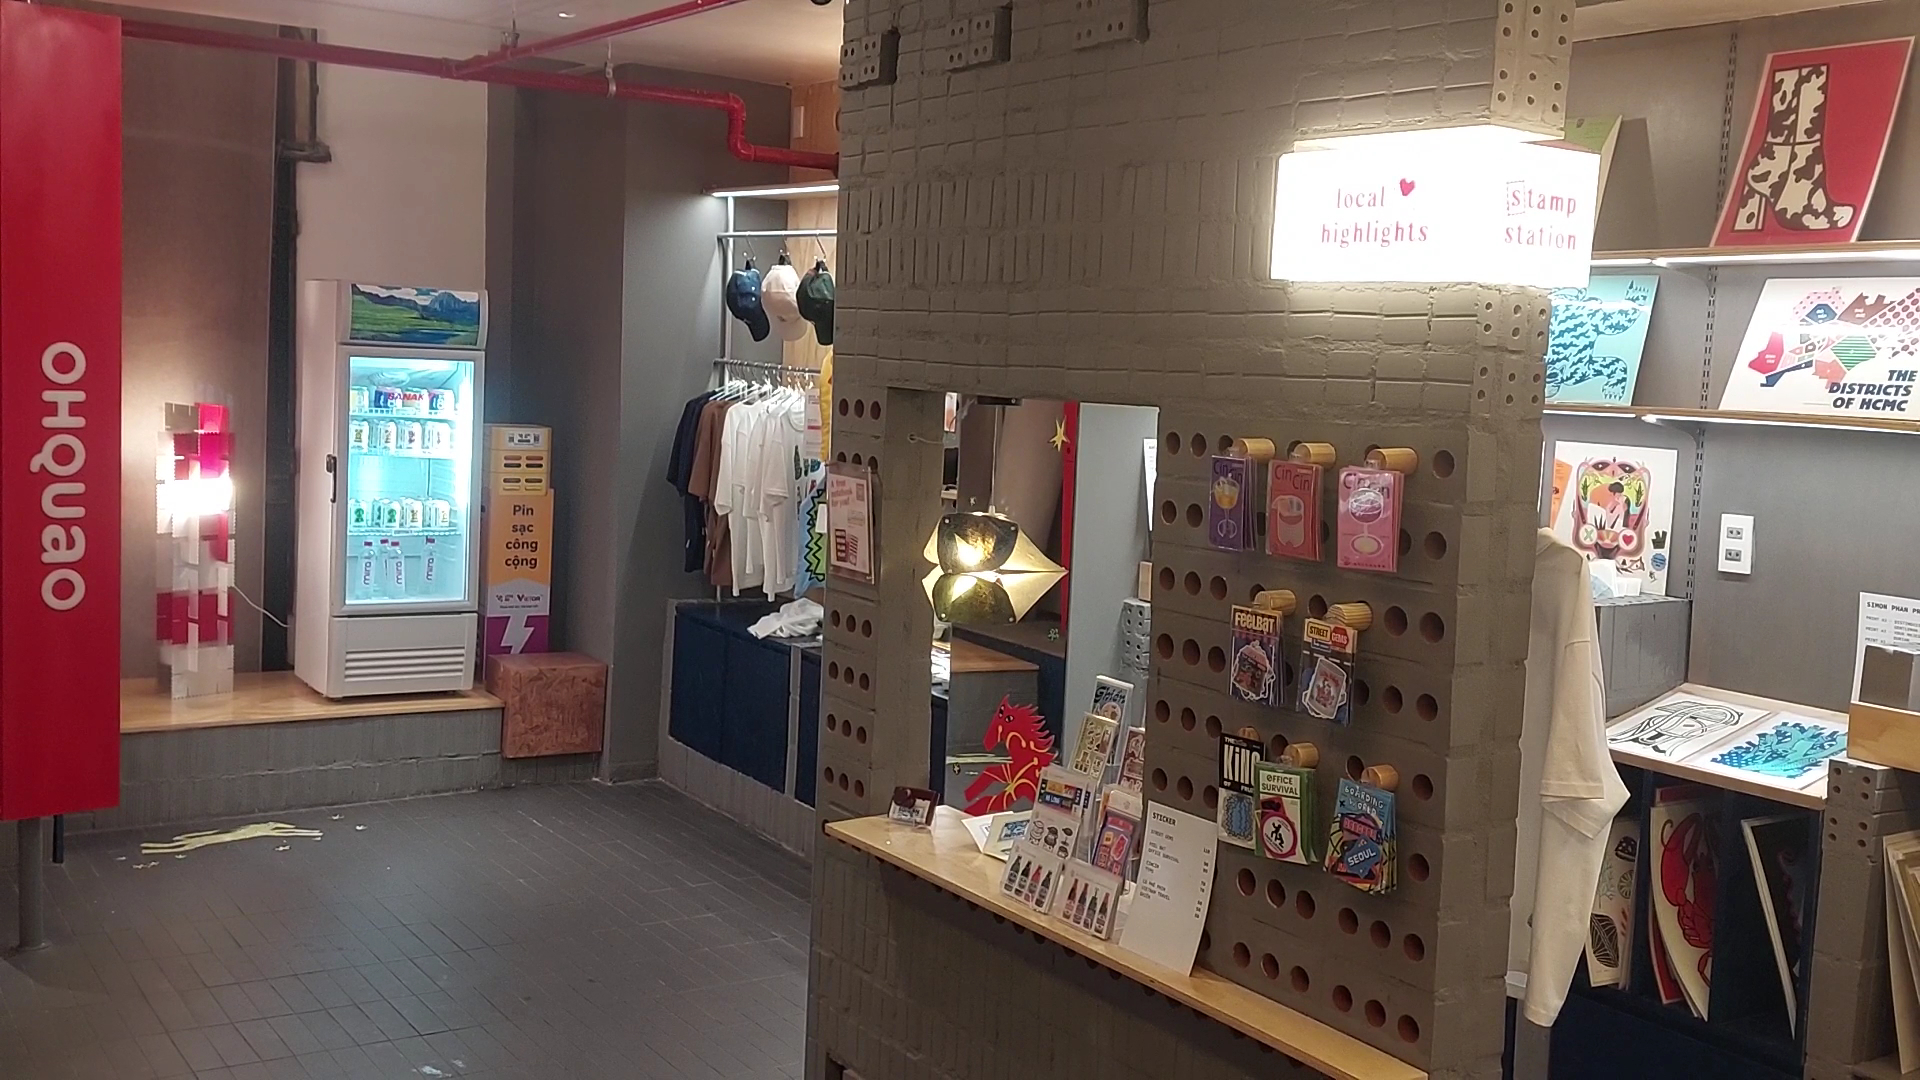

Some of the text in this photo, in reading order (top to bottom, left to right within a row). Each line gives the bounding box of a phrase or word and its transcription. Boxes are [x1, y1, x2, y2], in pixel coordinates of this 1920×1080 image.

[1338, 186, 1384, 208] local
[1512, 188, 1576, 218] stamp
[1322, 220, 1428, 248] highlights
[1505, 226, 1576, 250] station
[1888, 370, 1918, 382] THE
[1828, 382, 1913, 396] DISTRICTS
[1832, 397, 1908, 412] OF HCMC
[1274, 464, 1310, 490] Cin Cin
[513, 504, 534, 516] Pin
[512, 524, 534, 536] sạc
[506, 538, 538, 552] công
[504, 556, 538, 570] cộng
[1310, 626, 1328, 638] STREET
[1262, 782, 1298, 795] SURVIVAL
[1152, 812, 1176, 826] STICKER
[1348, 848, 1376, 866] SEOUL
